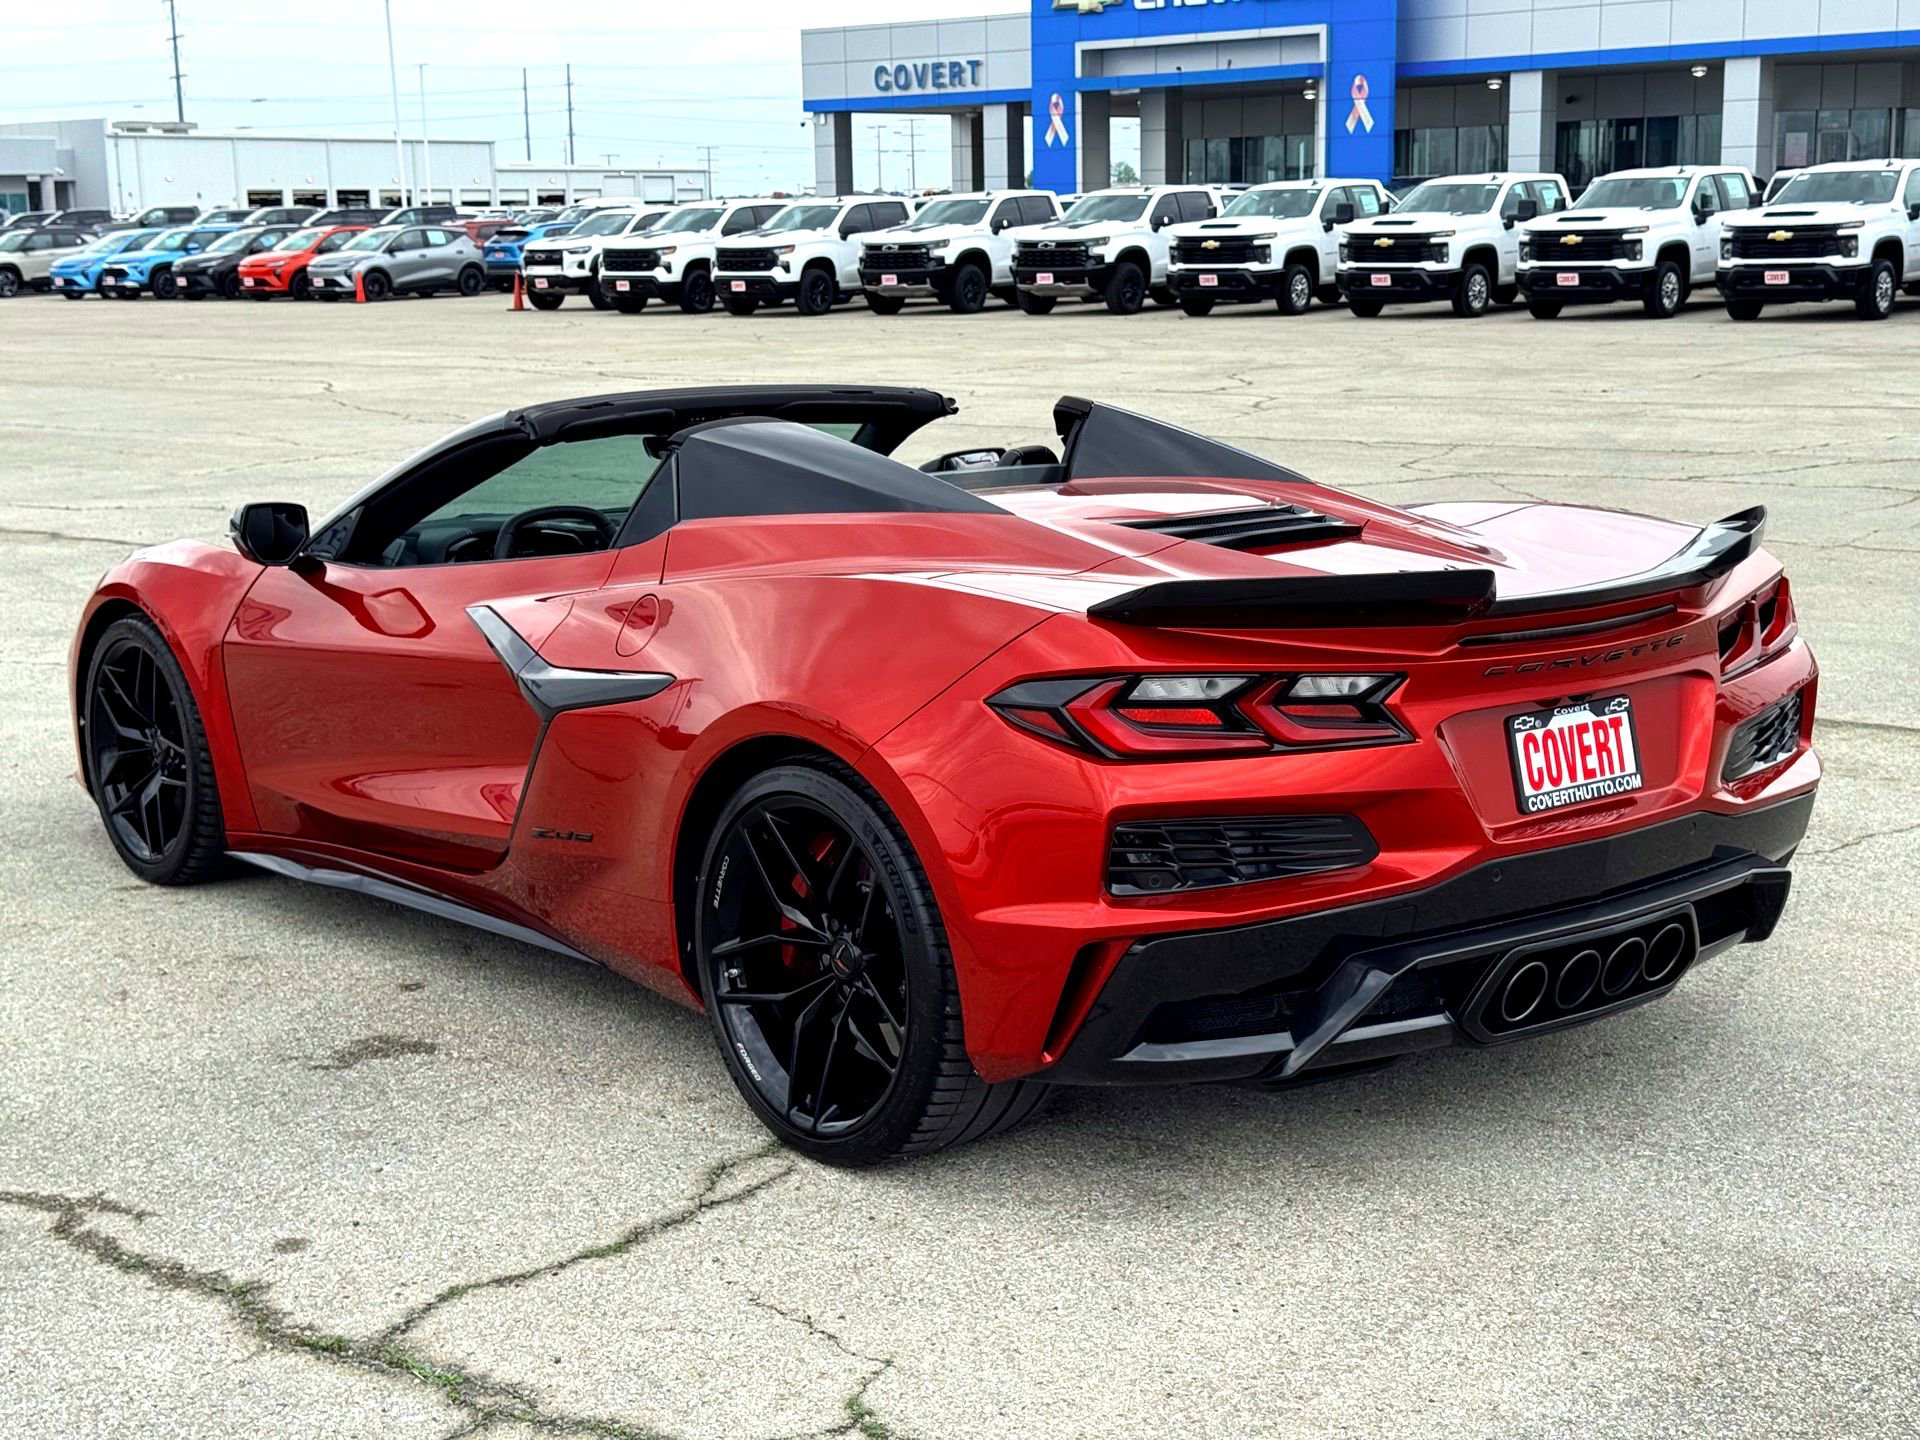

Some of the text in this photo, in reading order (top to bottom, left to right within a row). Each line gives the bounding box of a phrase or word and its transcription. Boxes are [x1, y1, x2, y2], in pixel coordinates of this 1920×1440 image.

[874, 60, 982, 91] COVERT
[1484, 634, 1687, 676] CORVETTE
[1553, 703, 1590, 716] Covert
[1523, 716, 1626, 792] COVERT
[1528, 774, 1642, 811] COVERTHUTTO.COM
[713, 855, 730, 909] CORVETTE
[737, 1042, 762, 1081] FORGED
